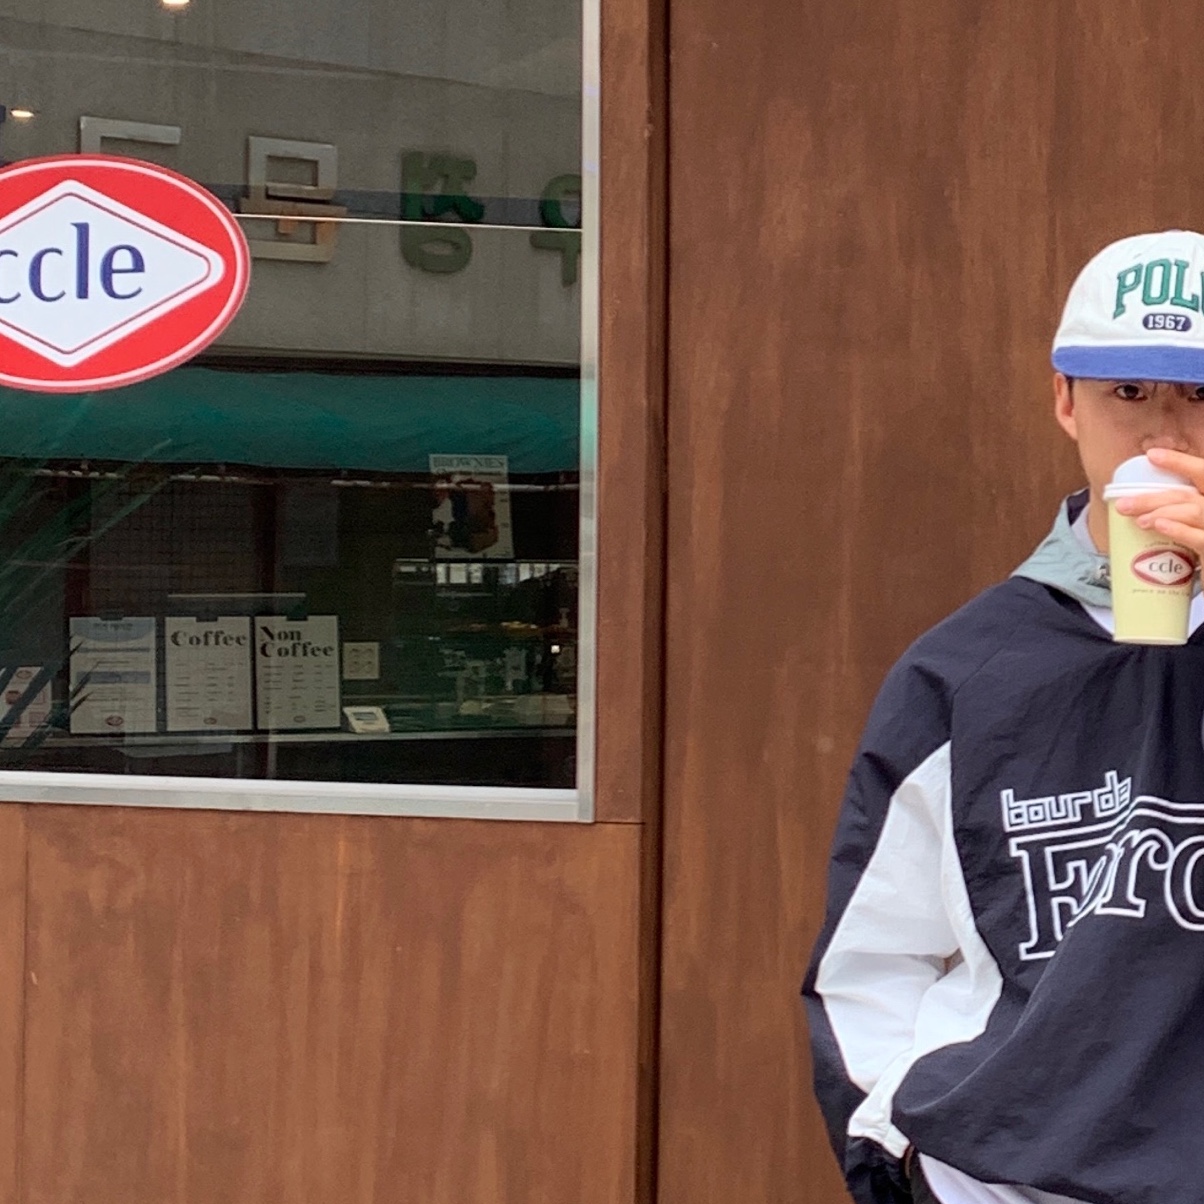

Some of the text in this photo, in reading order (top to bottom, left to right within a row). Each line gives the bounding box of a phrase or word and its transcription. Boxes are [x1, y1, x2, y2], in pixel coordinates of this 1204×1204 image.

[1147, 314, 1186, 330] 1967
[1148, 558, 1184, 575] ccle
[170, 630, 247, 647] Coffee
[260, 626, 301, 641] Non
[260, 642, 335, 658] Coffee
